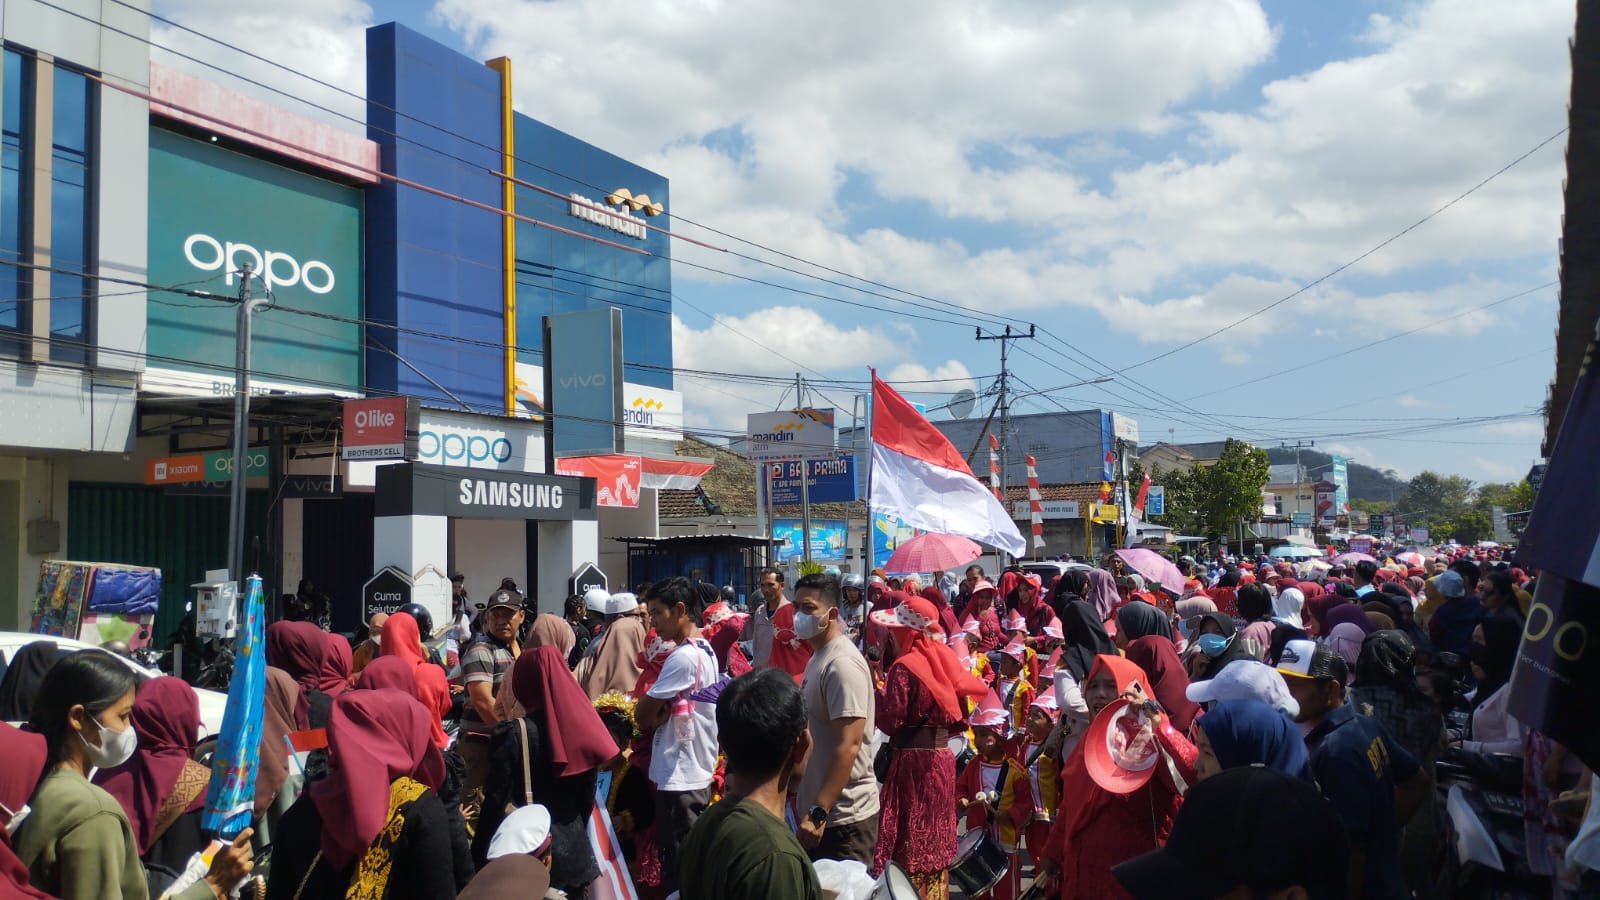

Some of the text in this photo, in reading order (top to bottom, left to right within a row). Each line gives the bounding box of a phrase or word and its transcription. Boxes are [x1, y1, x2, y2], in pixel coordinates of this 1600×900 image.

[570, 193, 647, 240] mandiri
[184, 233, 335, 295] oppo
[559, 371, 607, 389] vivo
[623, 407, 653, 425] andiri
[752, 429, 794, 441] mandiri
[347, 447, 401, 458] BROTHERS CELL
[459, 478, 563, 509] SAMSUNG
[373, 591, 402, 601] Cuma
